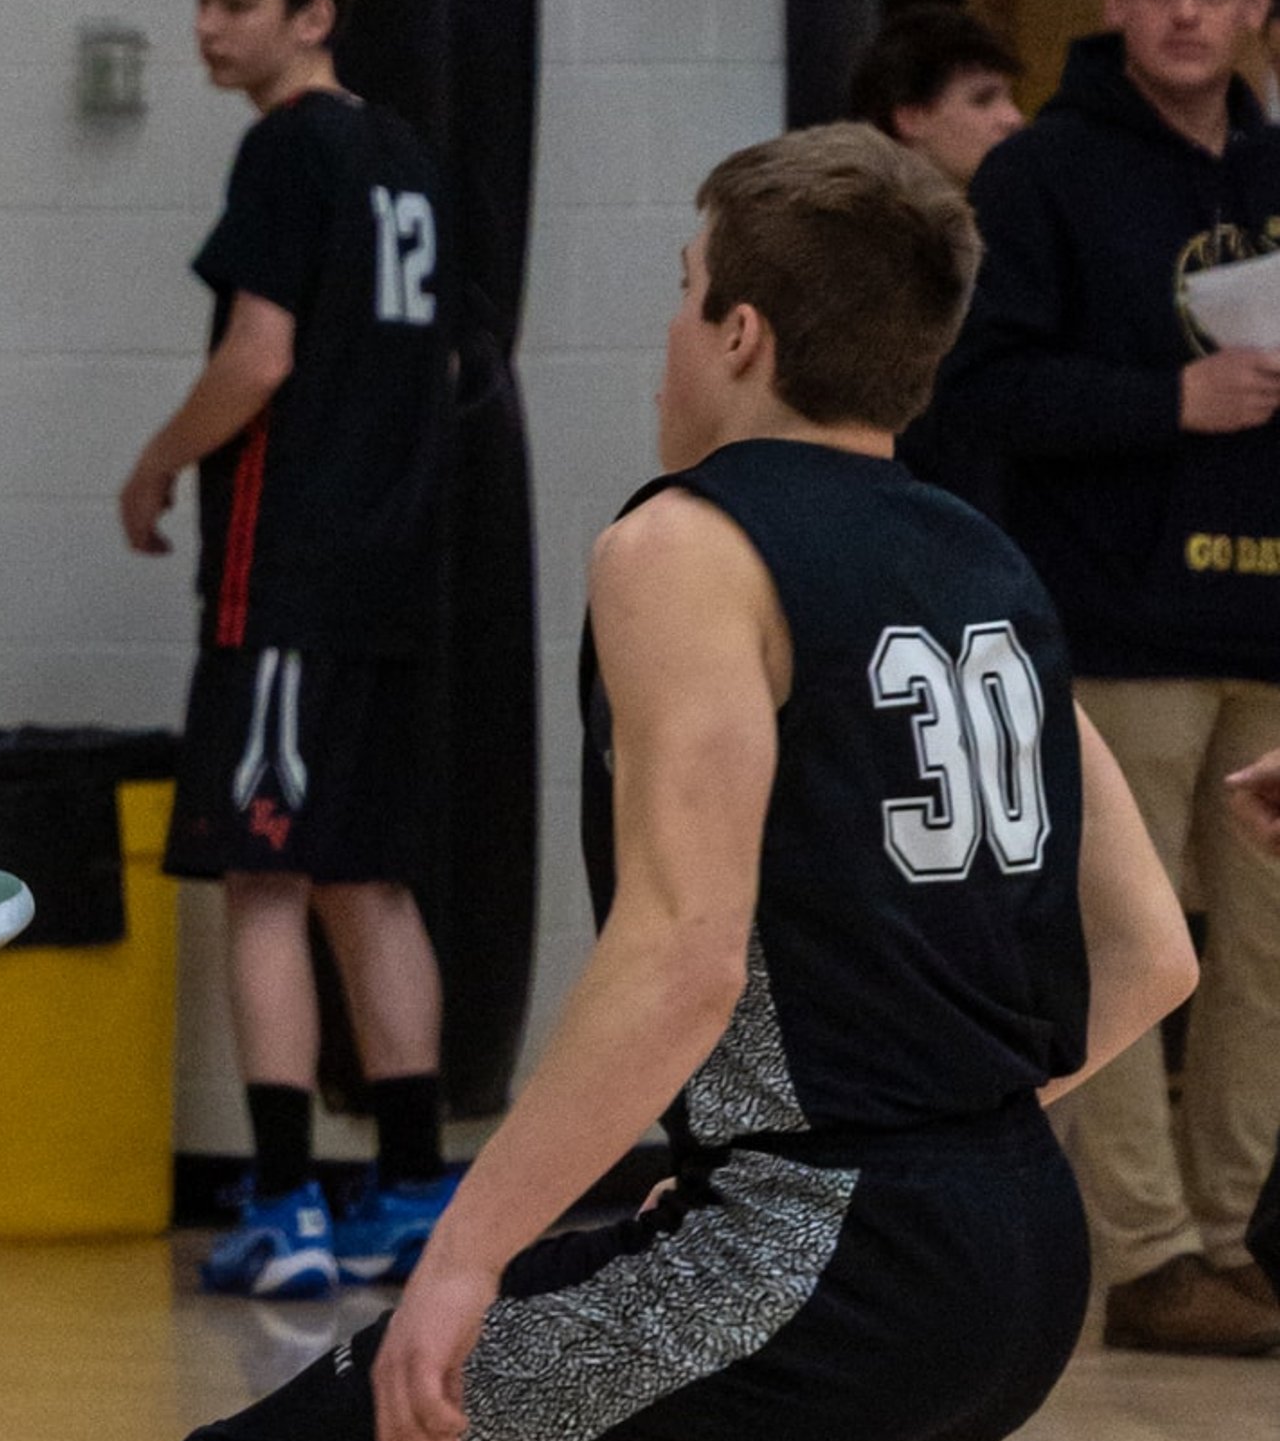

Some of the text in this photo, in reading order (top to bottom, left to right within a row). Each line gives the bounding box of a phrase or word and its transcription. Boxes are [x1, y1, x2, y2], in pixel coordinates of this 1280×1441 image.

[370, 184, 438, 326] 12
[1186, 532, 1233, 572] GO
[868, 620, 1052, 883] 30
